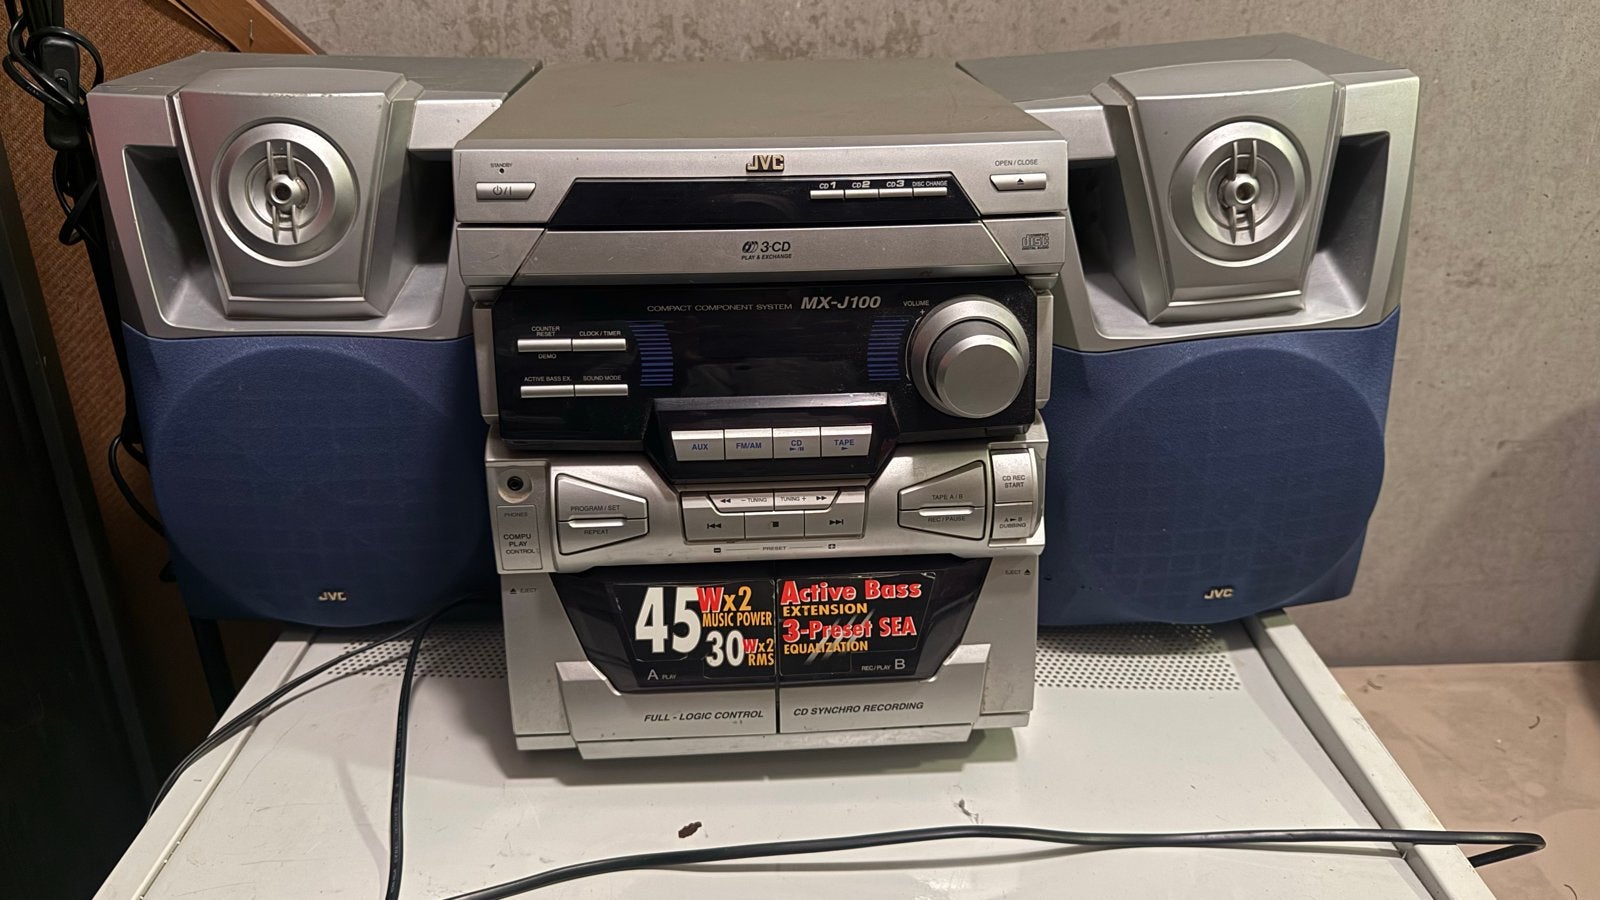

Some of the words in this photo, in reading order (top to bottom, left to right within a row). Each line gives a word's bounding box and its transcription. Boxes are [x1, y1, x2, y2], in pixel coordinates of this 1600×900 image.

[747, 155, 784, 171] JVC
[646, 304, 692, 312] COMPACT
[694, 304, 753, 312] COMPONENT
[755, 303, 793, 311] SYSTEM
[800, 295, 881, 310] MX-J100
[902, 299, 930, 307] VOLUME
[691, 442, 709, 451] AUX
[735, 441, 762, 450] FM/AM
[790, 439, 803, 447] CD
[834, 438, 855, 447] TAPE
[1002, 474, 1011, 482] CD
[1004, 481, 1025, 489] START
[503, 533, 532, 541] COMPU
[508, 540, 528, 548] PLAY
[318, 591, 347, 601] JVC
[780, 580, 857, 606] Active
[864, 579, 922, 600] Bass
[1204, 588, 1233, 600] JVC
[782, 603, 868, 617] EXTENSION
[635, 586, 701, 654] 45
[702, 612, 734, 628] MUSIC
[736, 611, 773, 627] POWER
[782, 618, 873, 643] 3-Preset
[879, 616, 917, 637] SEA
[705, 630, 745, 668] 30
[784, 641, 869, 655] EQUALIZATION
[748, 653, 775, 666] RMS
[894, 658, 906, 670] B
[647, 669, 659, 681] A
[793, 708, 808, 717] CD
[811, 705, 860, 715] SYNCHRO
[863, 701, 924, 712] RECORDING
[644, 714, 670, 722] FULL
[679, 713, 712, 721] LOGIC
[714, 710, 764, 720] CONTROL
